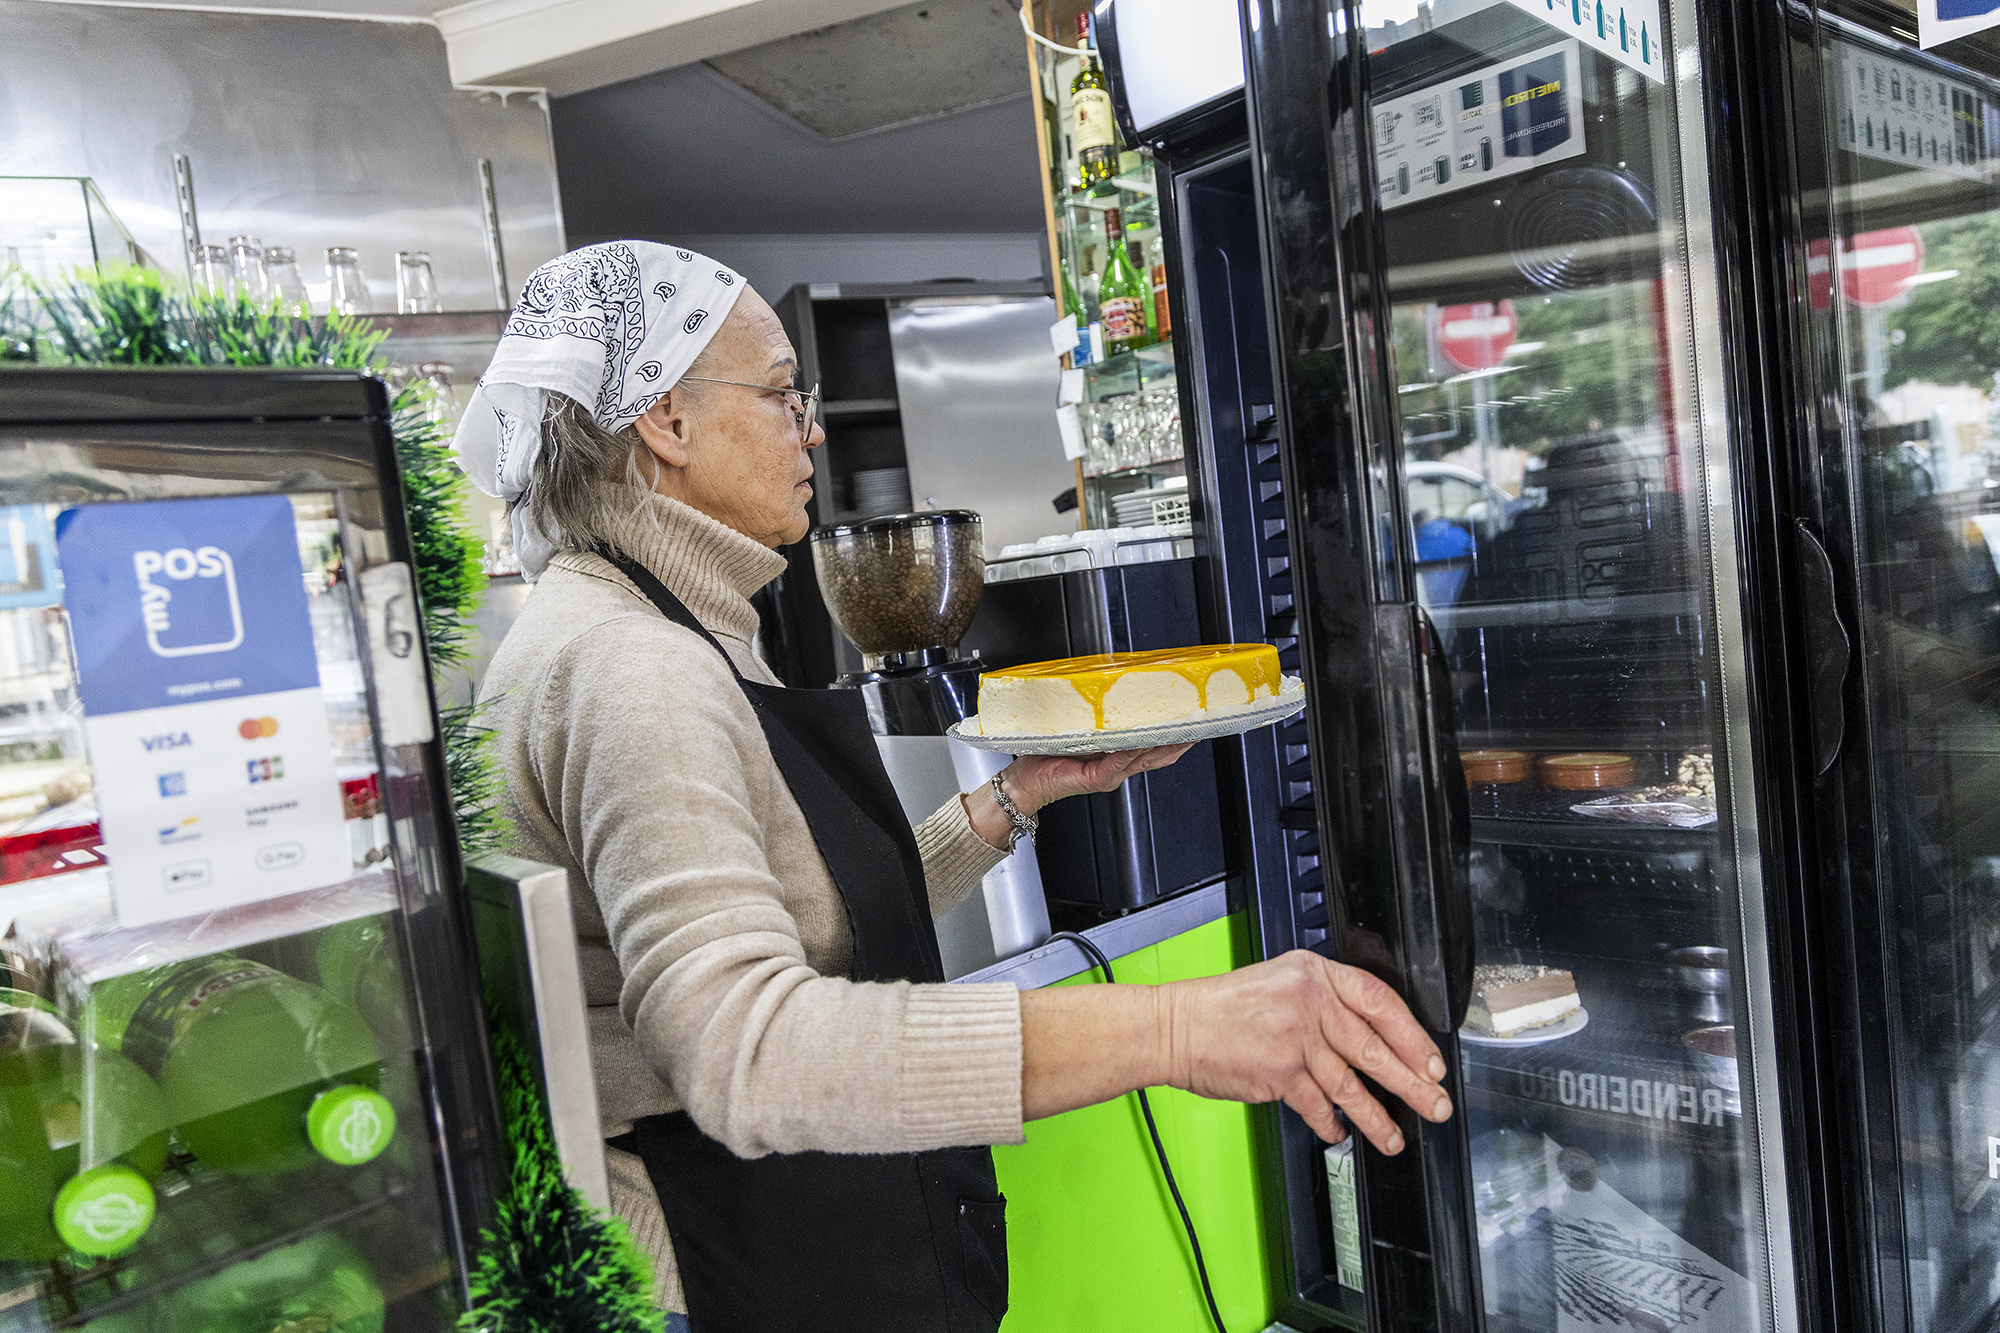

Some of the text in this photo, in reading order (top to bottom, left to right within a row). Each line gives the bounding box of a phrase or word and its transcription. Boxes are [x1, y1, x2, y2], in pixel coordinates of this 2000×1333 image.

[134, 546, 224, 580] POS
[167, 677, 243, 696] mypos.com
[141, 731, 192, 752] VISA
